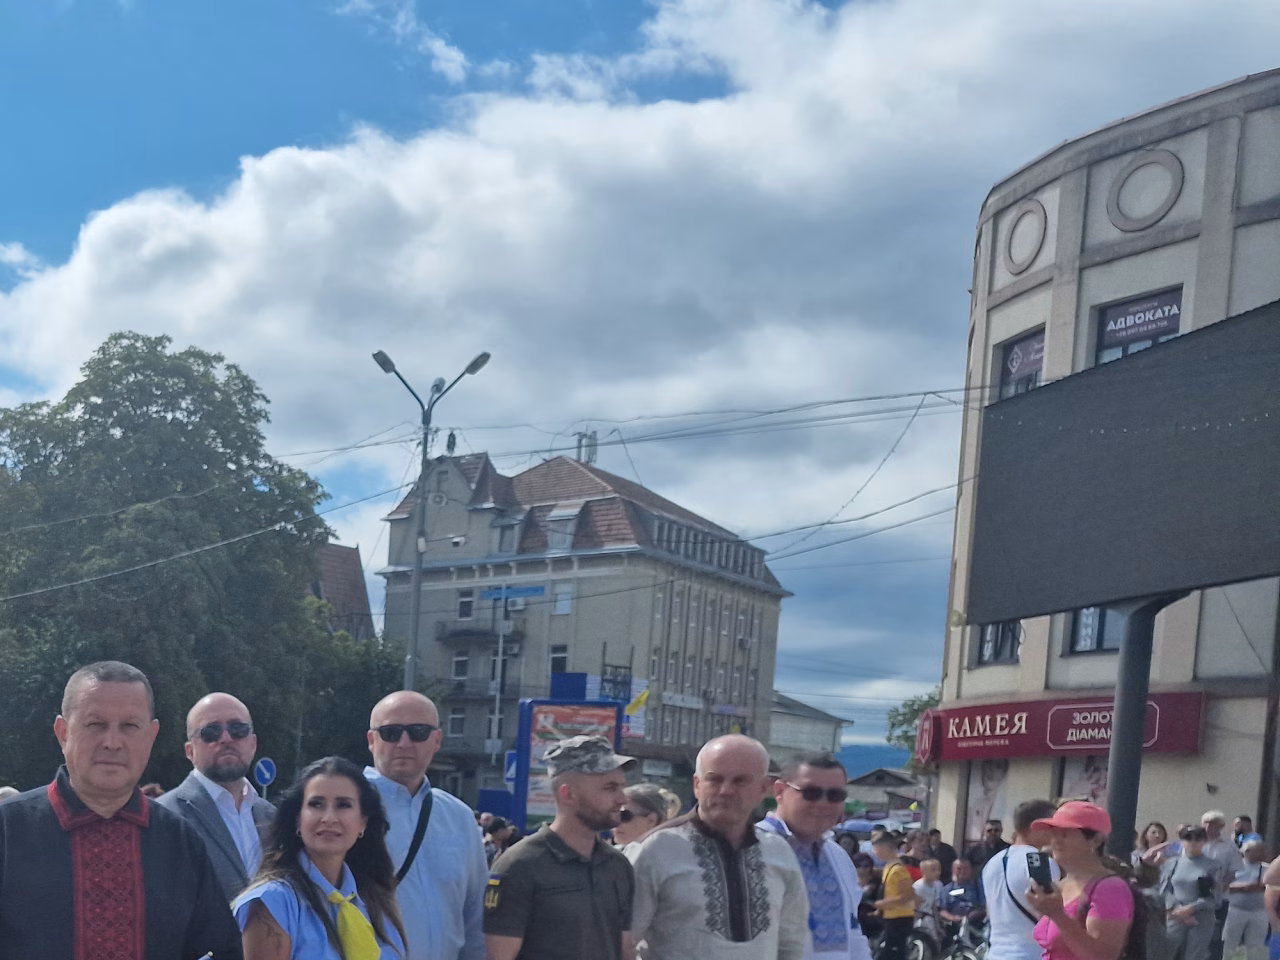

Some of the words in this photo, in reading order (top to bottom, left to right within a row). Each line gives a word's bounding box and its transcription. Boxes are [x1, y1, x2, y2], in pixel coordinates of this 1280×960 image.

[1106, 304, 1180, 331] АДВОКАТА
[947, 711, 1028, 739] КАМЕЯ
[1072, 711, 1115, 725] ЗОЛОТ
[1067, 727, 1113, 742] ДІАМАН
